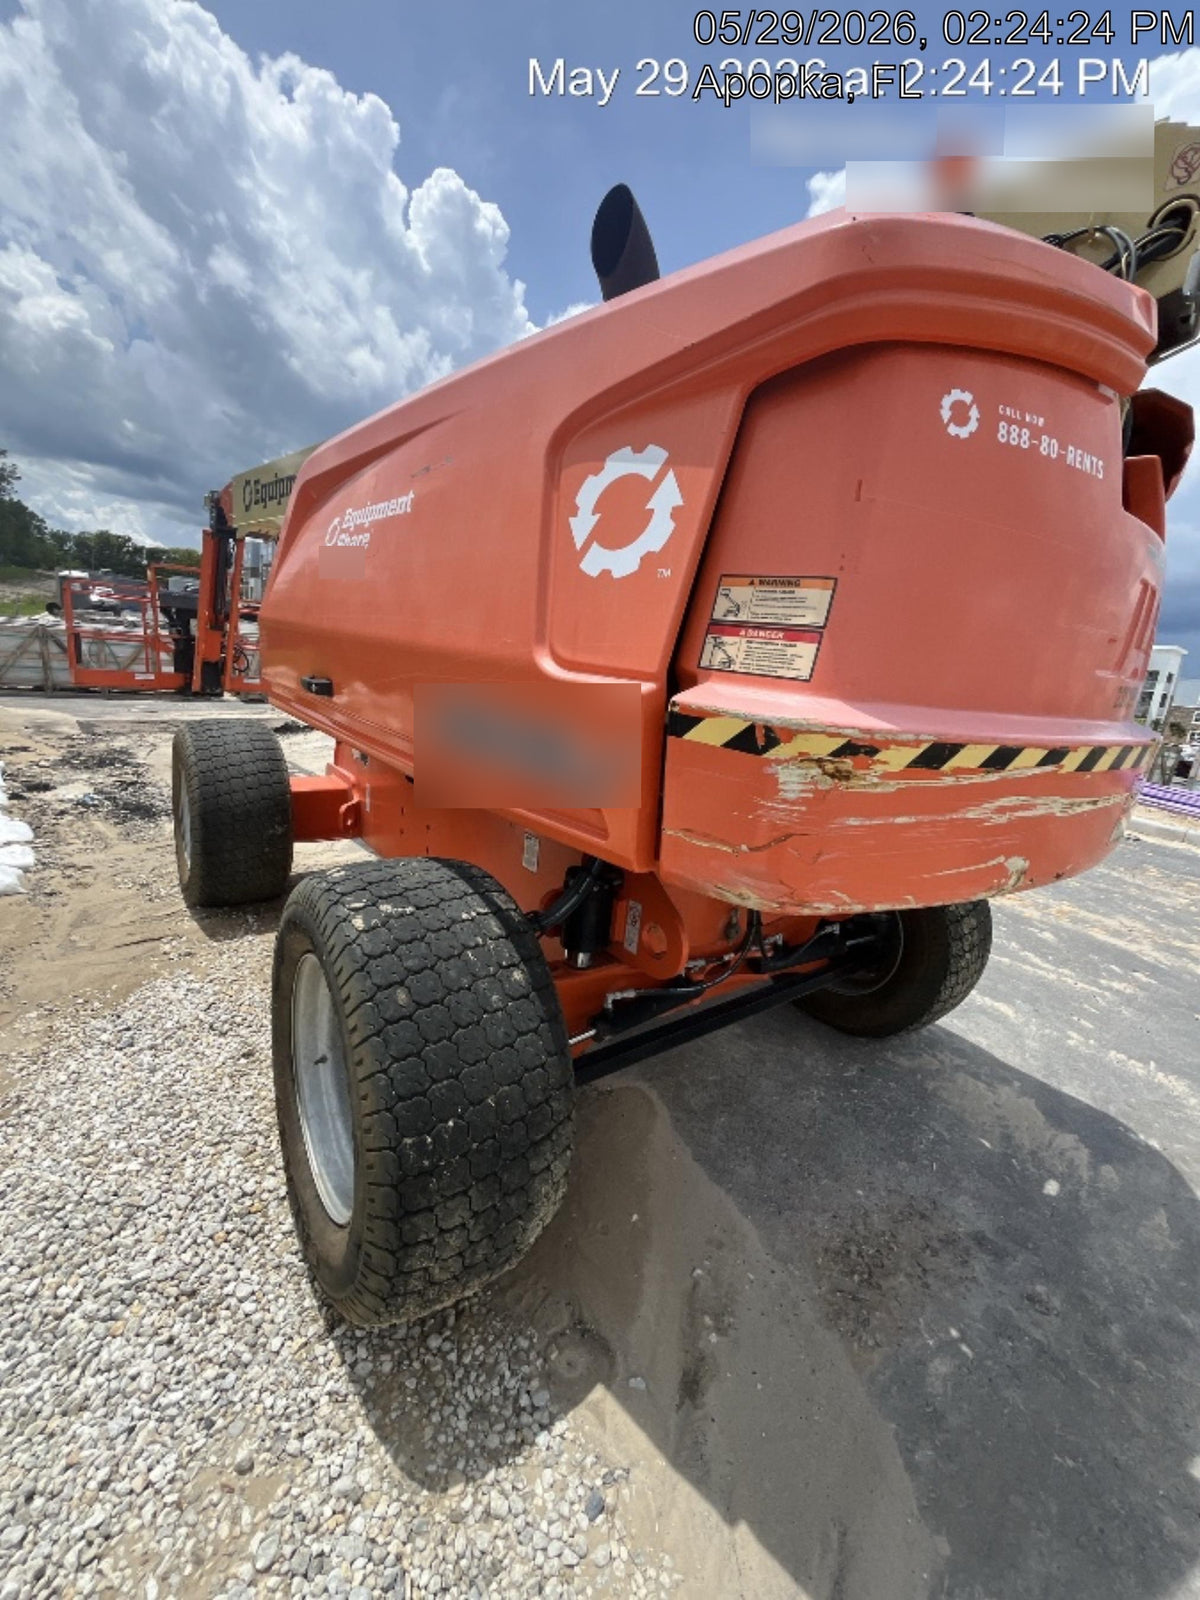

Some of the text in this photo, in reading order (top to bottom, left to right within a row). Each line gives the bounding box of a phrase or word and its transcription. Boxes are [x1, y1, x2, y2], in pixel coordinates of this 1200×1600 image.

[998, 404, 1022, 421] CALL
[997, 420, 1105, 480] 888-80-RENTS
[253, 472, 297, 509] Equipm
[341, 489, 415, 531] Equipment
